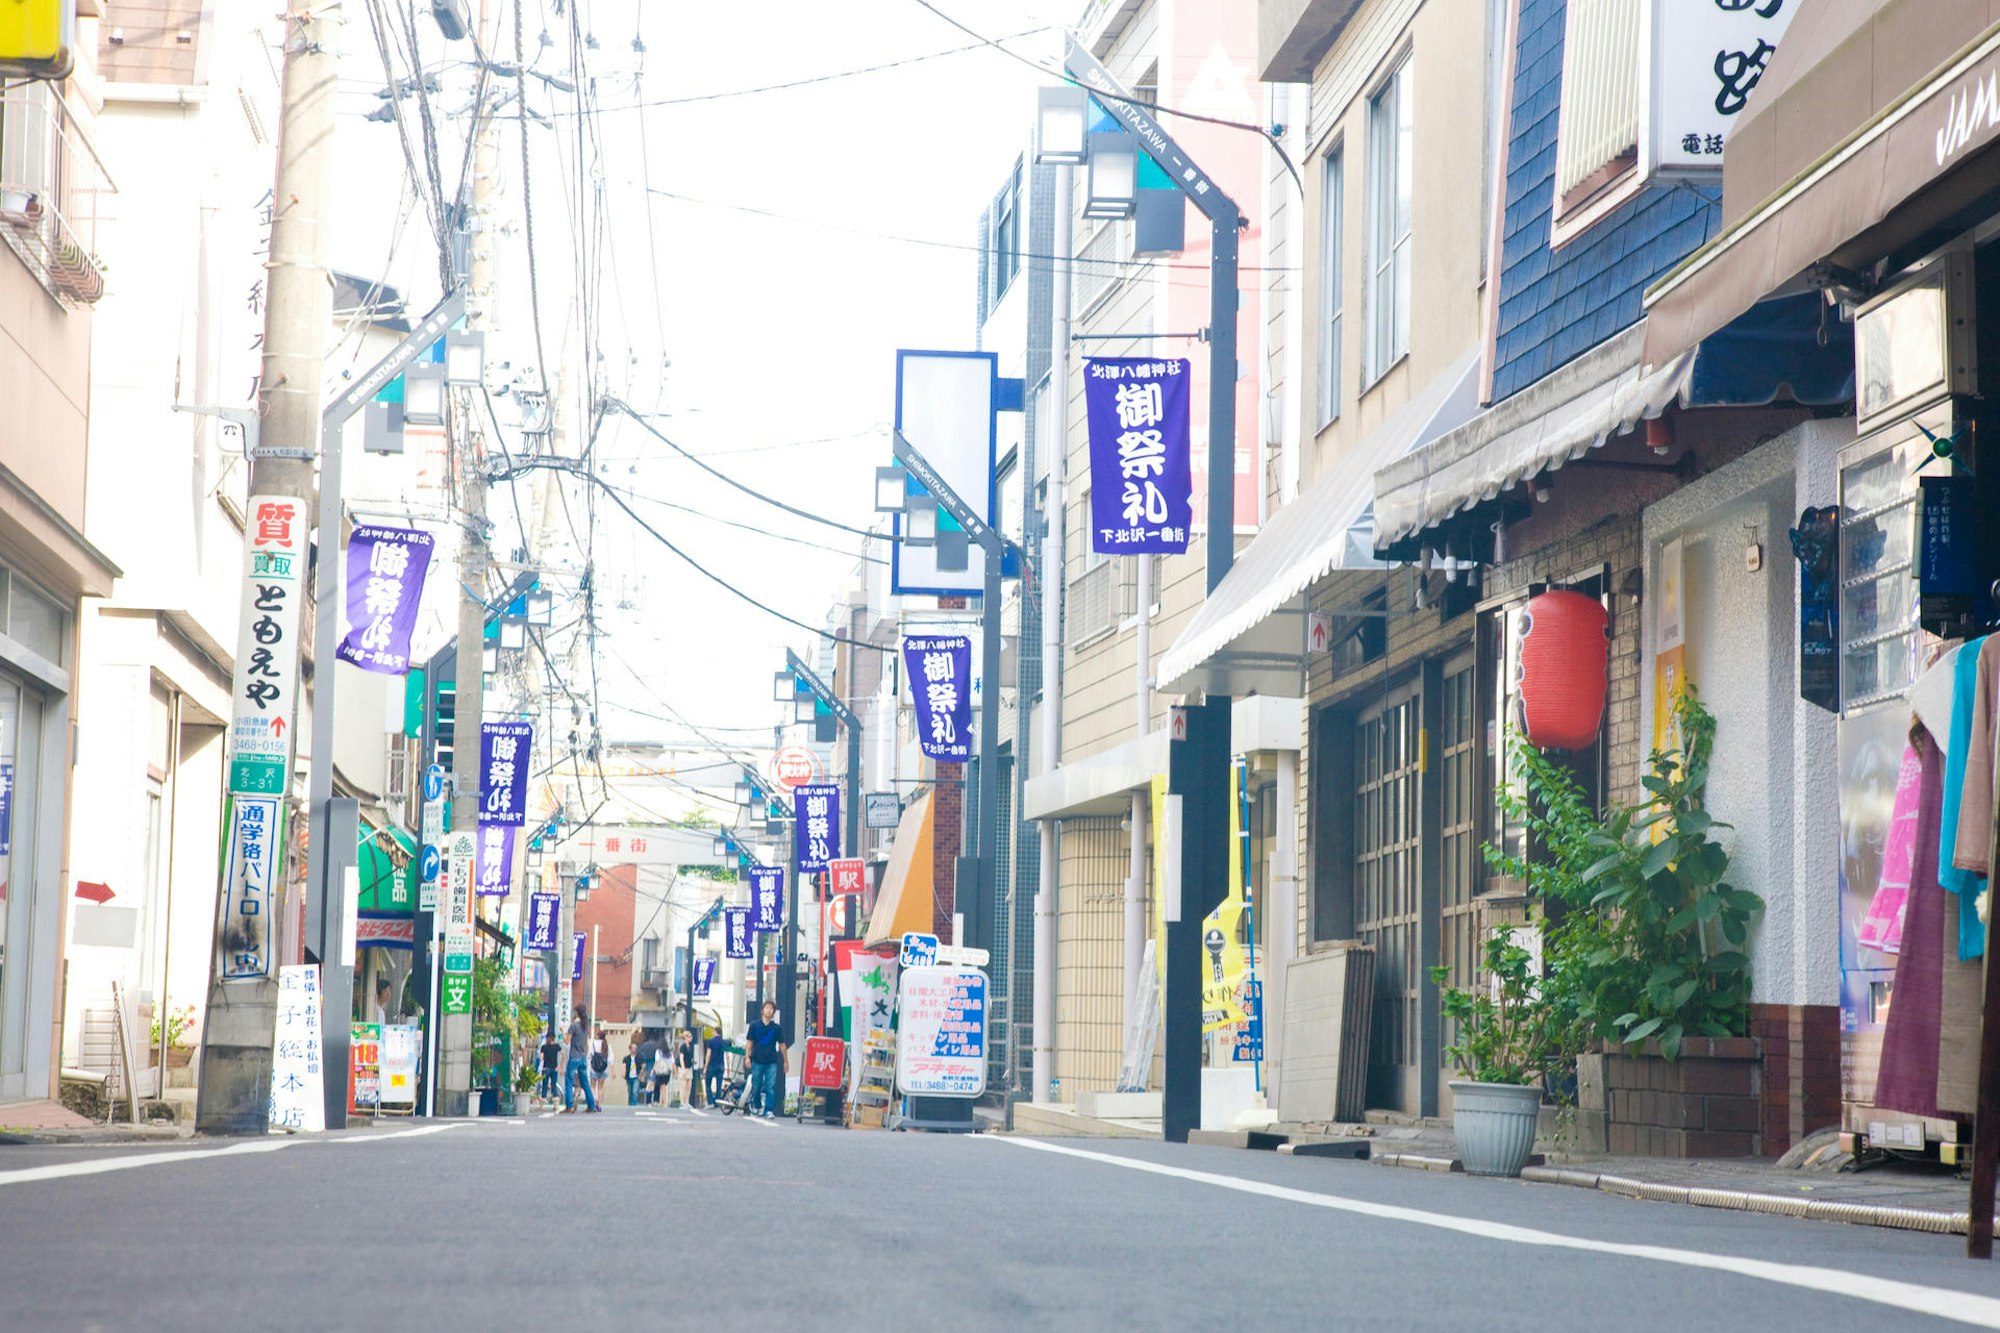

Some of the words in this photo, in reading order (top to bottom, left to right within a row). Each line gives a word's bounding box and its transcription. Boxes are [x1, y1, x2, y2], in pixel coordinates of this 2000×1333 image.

[1681, 133, 1724, 155] 電話
[1091, 361, 1182, 380] 北澤八幡神社
[1115, 382, 1169, 527] 御祭礼
[253, 503, 296, 547] 質
[1100, 527, 1185, 544] 下北沢一番街
[253, 555, 292, 576] 買取
[246, 583, 287, 711] ともえや
[923, 652, 958, 744] 御祭礼
[240, 778, 273, 789] 3-31
[807, 796, 830, 860] 御祭礼
[578, 837, 648, 853] 一番街
[838, 871, 860, 890] 駅
[759, 876, 775, 923] 御祭礼
[447, 986, 467, 1007] 文
[908, 987, 969, 999] 日曜大工用品
[279, 971, 305, 1129] 金子総本店
[812, 1052, 836, 1071] 駅
